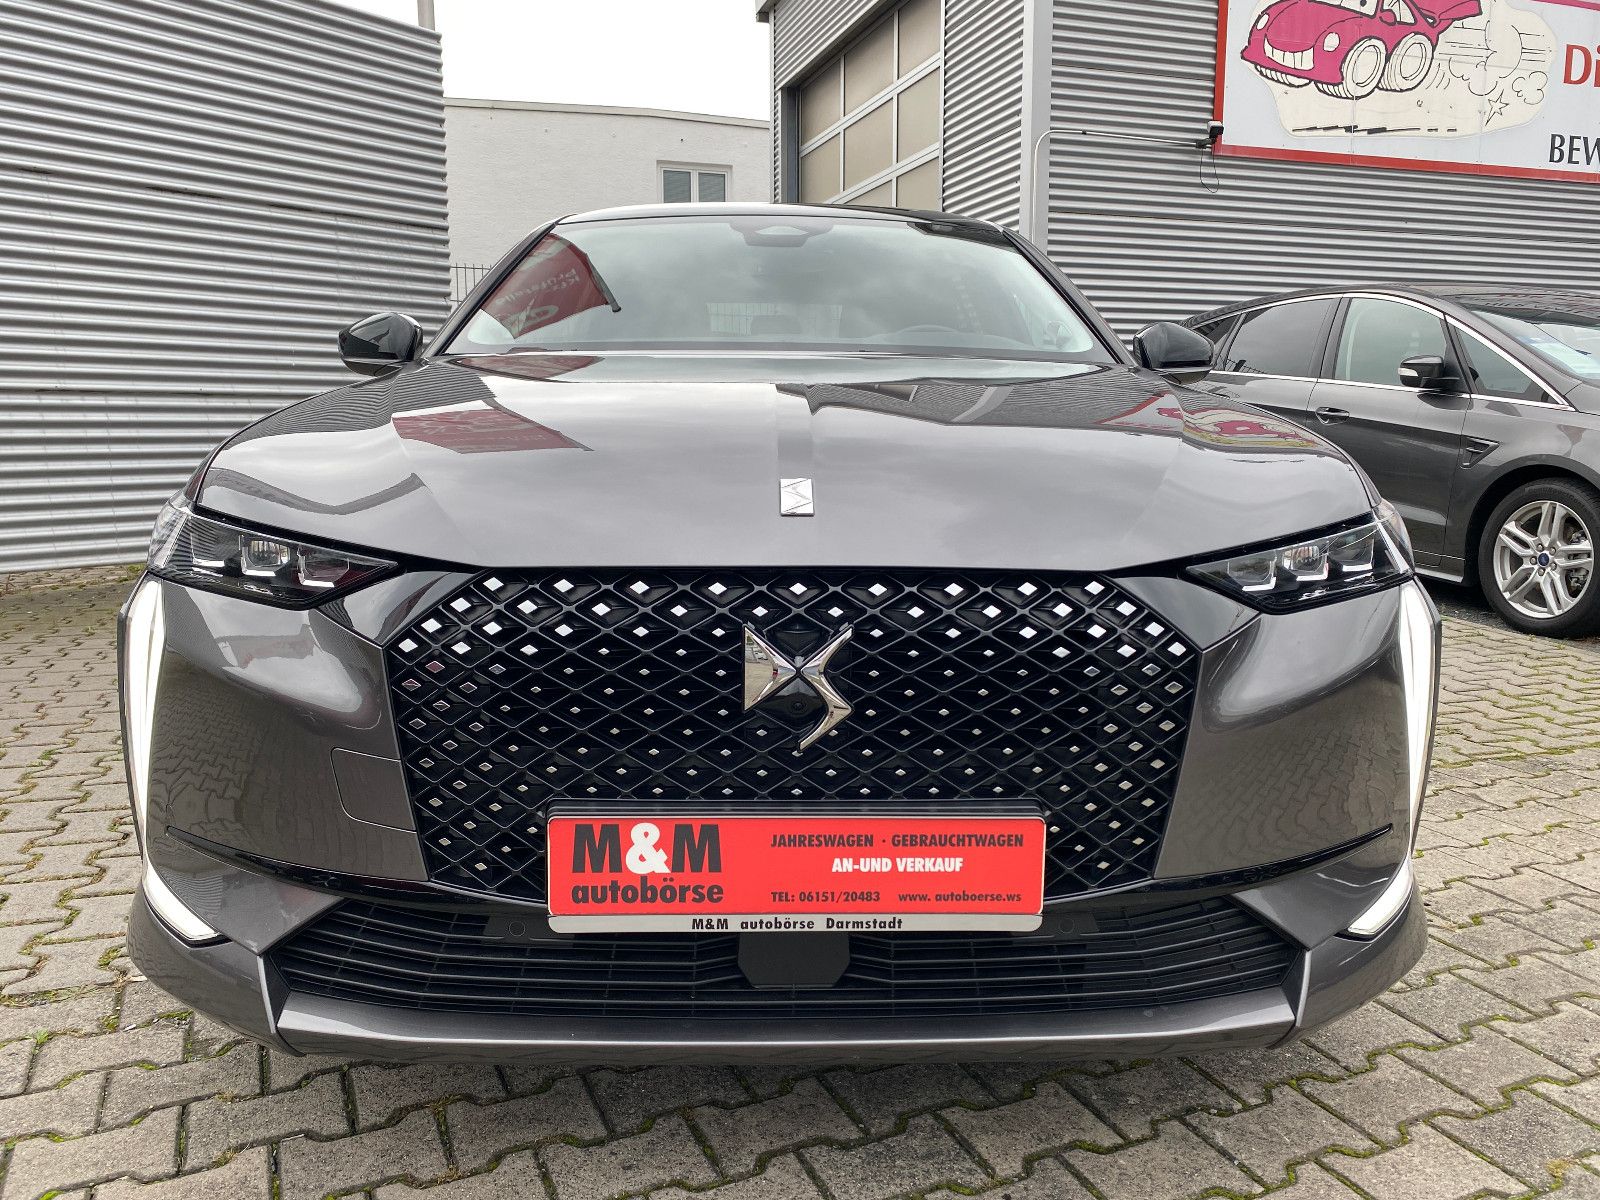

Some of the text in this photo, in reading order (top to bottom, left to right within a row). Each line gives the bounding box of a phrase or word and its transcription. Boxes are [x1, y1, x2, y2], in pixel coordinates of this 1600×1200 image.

[770, 833, 1025, 848] JAHRESWAGEN GEBRAUCHTWAGEN
[571, 822, 723, 875] M&M
[831, 856, 964, 874] AN-UND VERKAUF
[570, 875, 724, 905] autobörse
[770, 890, 881, 903] TEL: 06151/20483
[934, 889, 1022, 903] autoboerse.ws
[691, 916, 903, 931] M&M autobörse Darmstadt
